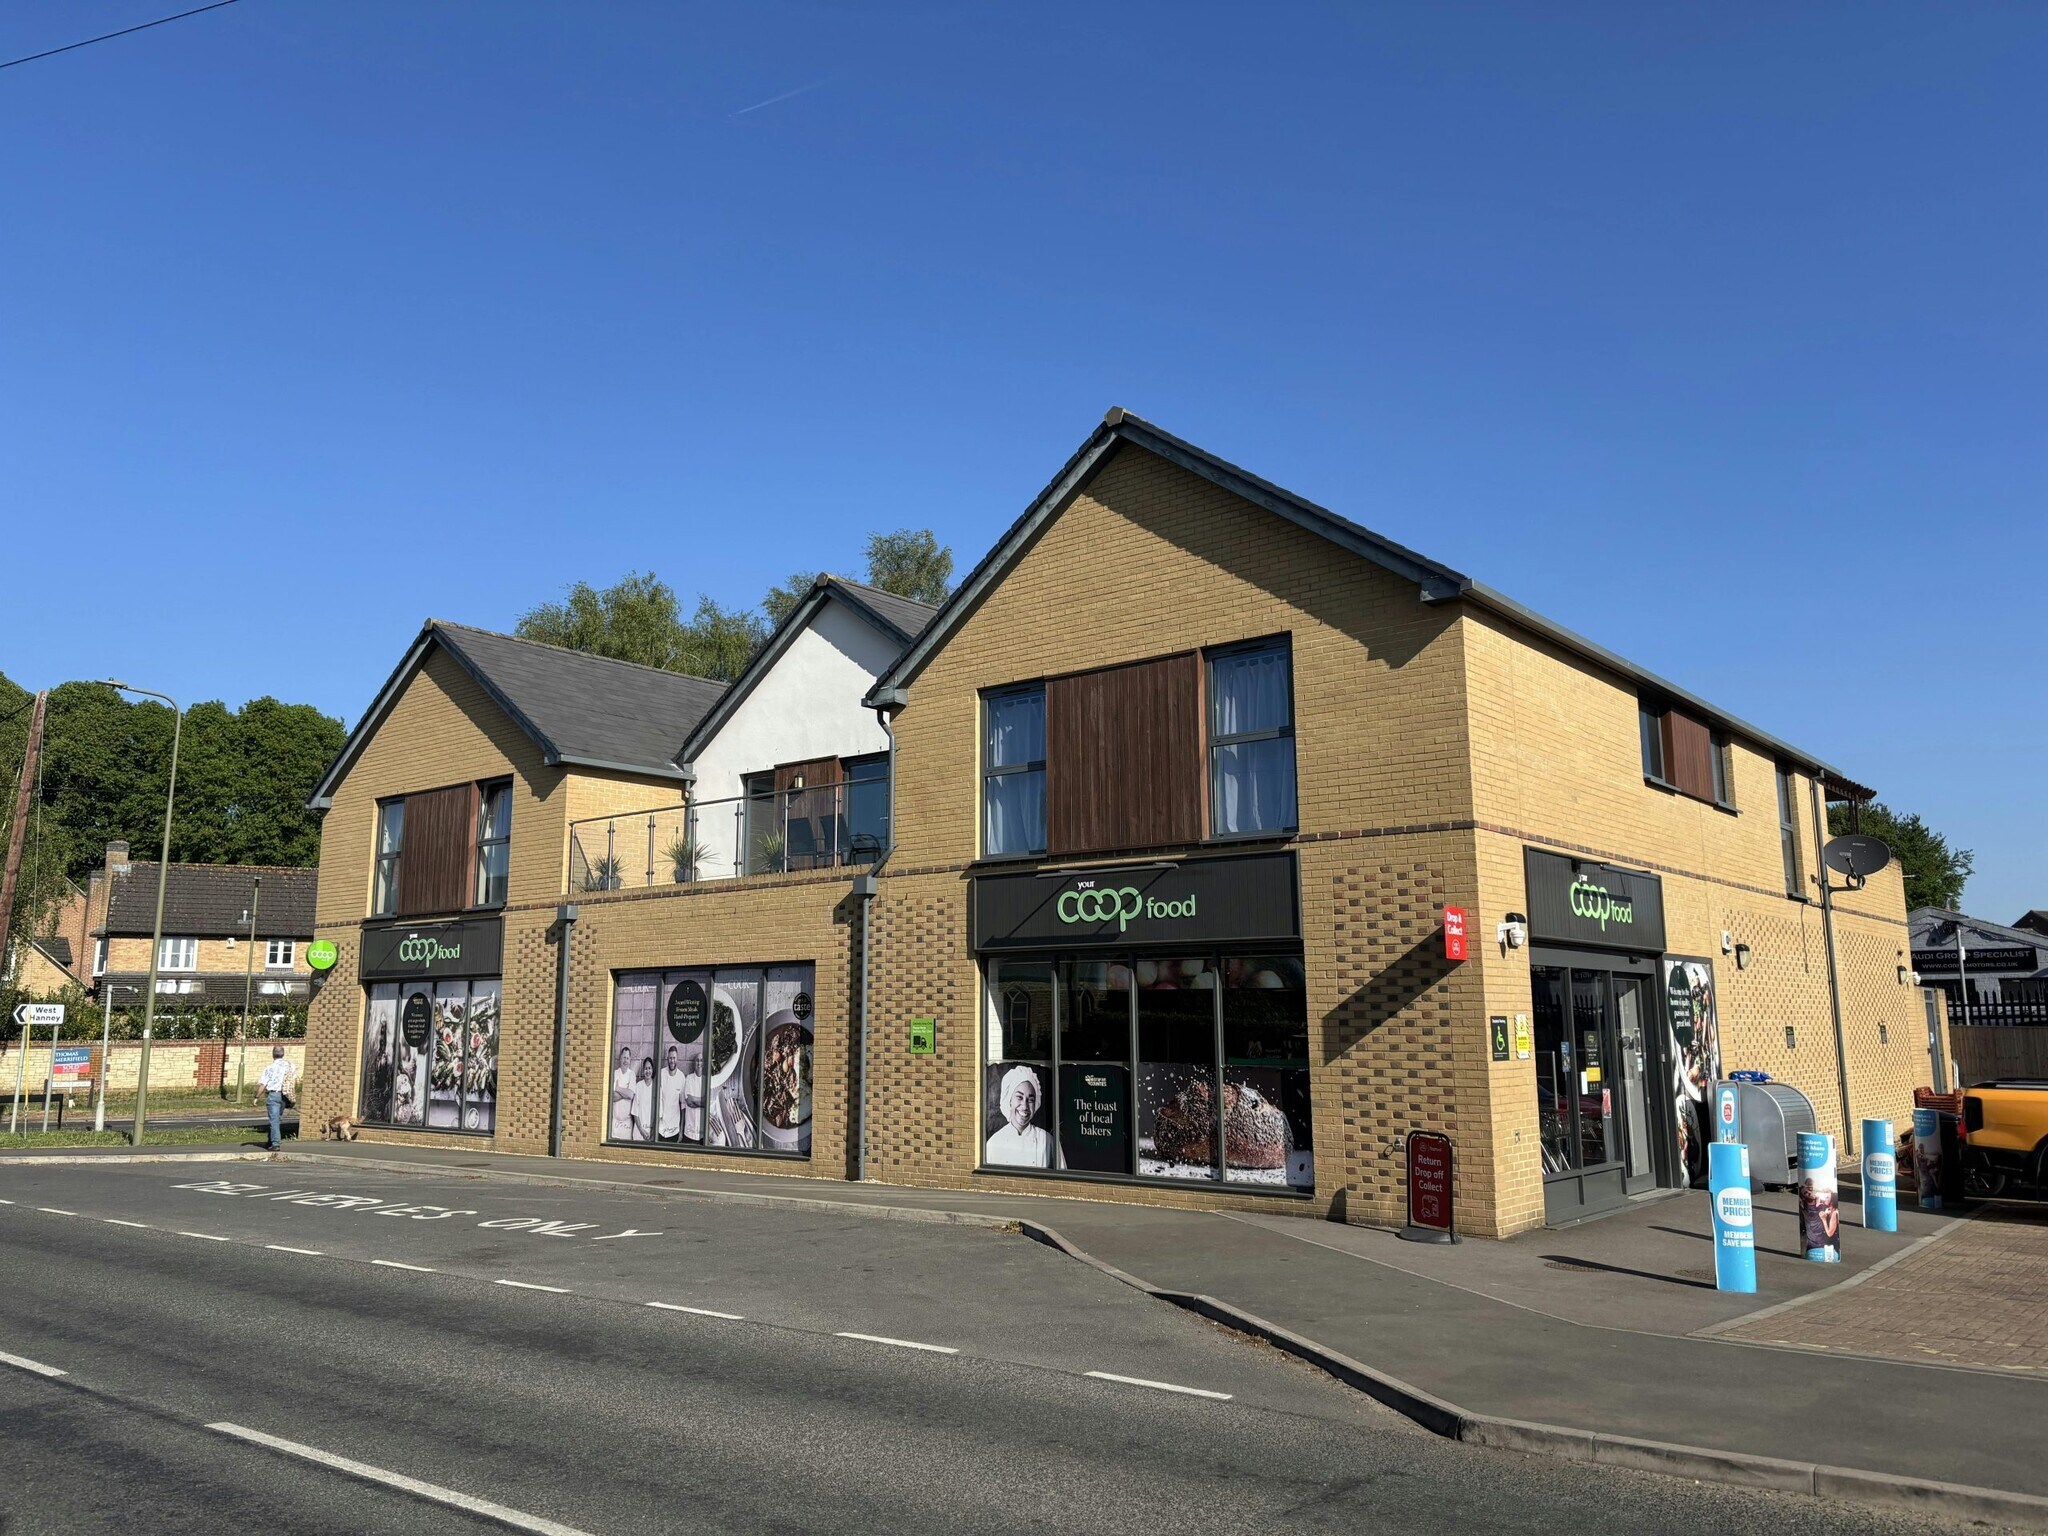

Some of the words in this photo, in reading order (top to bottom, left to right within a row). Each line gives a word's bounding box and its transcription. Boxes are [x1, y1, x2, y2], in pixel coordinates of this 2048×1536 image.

[1077, 880, 1096, 890] your
[1057, 886, 1143, 933] coop
[1146, 894, 1196, 919] food
[1570, 881, 1610, 932] coop
[1611, 900, 1633, 924] food
[400, 937, 438, 968] coop
[438, 944, 460, 959] food
[1936, 951, 1971, 960] GROP
[1973, 950, 2031, 959] SPECIALIST
[793, 1003, 811, 1011] taste
[30, 1014, 61, 1022] Hanney
[1074, 1098, 1092, 1110] The
[1094, 1101, 1117, 1111] toast
[1079, 1111, 1089, 1122] of
[1091, 1112, 1113, 1124] local
[1081, 1124, 1112, 1136] bakers
[1418, 1154, 1442, 1166] Return
[1415, 1166, 1432, 1179] Drop
[1433, 1170, 1445, 1179] off
[1869, 1166, 1893, 1175] PRICES
[1418, 1180, 1443, 1193] Collect
[169, 1181, 478, 1219] DELIVERIES
[477, 1207, 664, 1240] ONLY
[1723, 1206, 1751, 1217] PRICES
[1722, 1238, 1740, 1247] SAVE
